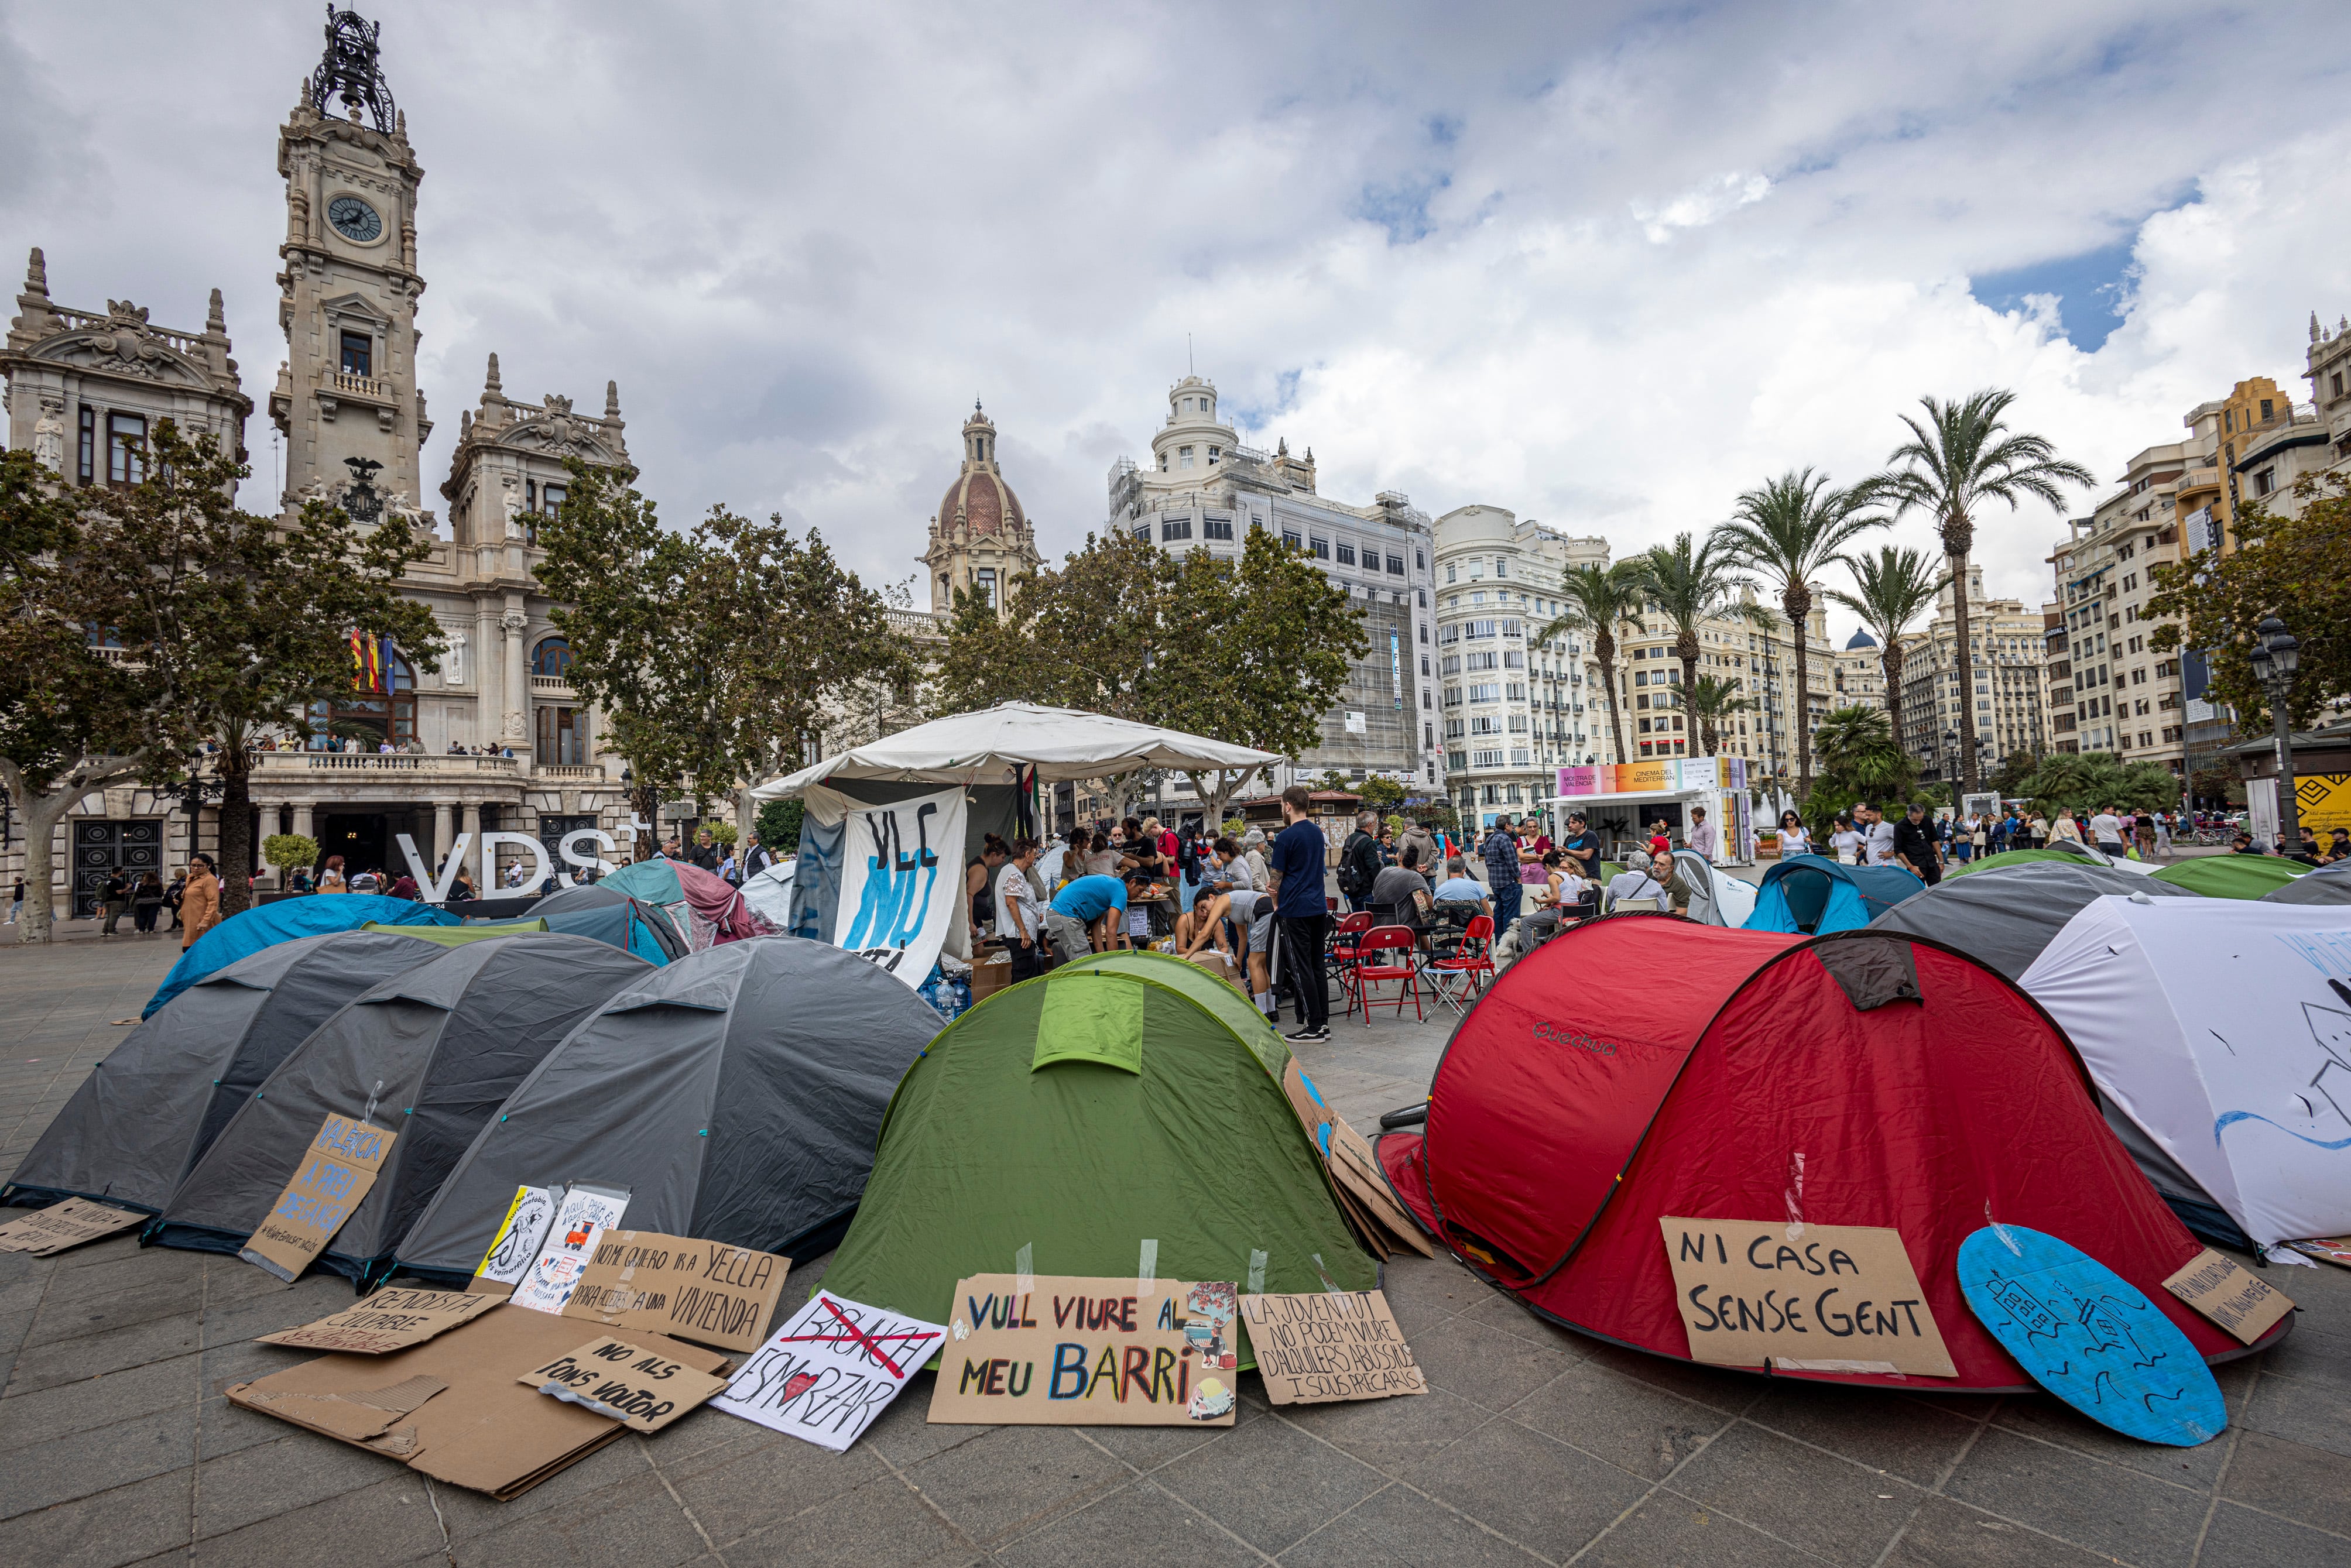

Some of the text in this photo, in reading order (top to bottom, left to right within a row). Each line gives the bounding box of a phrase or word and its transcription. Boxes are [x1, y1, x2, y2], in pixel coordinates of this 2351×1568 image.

[2227, 455, 2238, 520] RIALTO
[866, 802, 939, 872] VLC
[843, 847, 938, 950] NO
[1533, 1022, 1616, 1056] Quechua
[300, 1159, 358, 1200] A PREU
[516, 1196, 525, 1205] No
[488, 1262, 495, 1272] és
[493, 1252, 532, 1276] veïnatfilia
[624, 1246, 669, 1270] QUIERO
[702, 1244, 773, 1290] YECLA
[1680, 1231, 1859, 1276] NI CASA
[361, 1289, 488, 1313] RENDISTA
[2170, 1285, 2194, 1302] POR
[2196, 1262, 2226, 1290] CIUDAD
[327, 1311, 430, 1332] CULPABLE
[571, 1285, 598, 1310] PARA
[599, 1288, 628, 1309] ACCEDER
[633, 1291, 646, 1311] A
[645, 1292, 667, 1310] UNA
[670, 1285, 760, 1337] VIVIENDA
[967, 1292, 1189, 1333] VULL VIURE AL
[1246, 1291, 1376, 1324] LA JOVENTUT
[1688, 1284, 1921, 1337] SENSE GENT
[789, 1299, 935, 1374] BRUNCH
[1269, 1320, 1397, 1349] NO PODEM VIURE
[592, 1343, 682, 1380] NO ALS
[959, 1357, 1035, 1398] MEU
[1262, 1346, 1351, 1377] D'ALQUILERS
[534, 1357, 675, 1423] FONS VOLTOR
[1287, 1371, 1420, 1398] I SOUS PRECARIS
